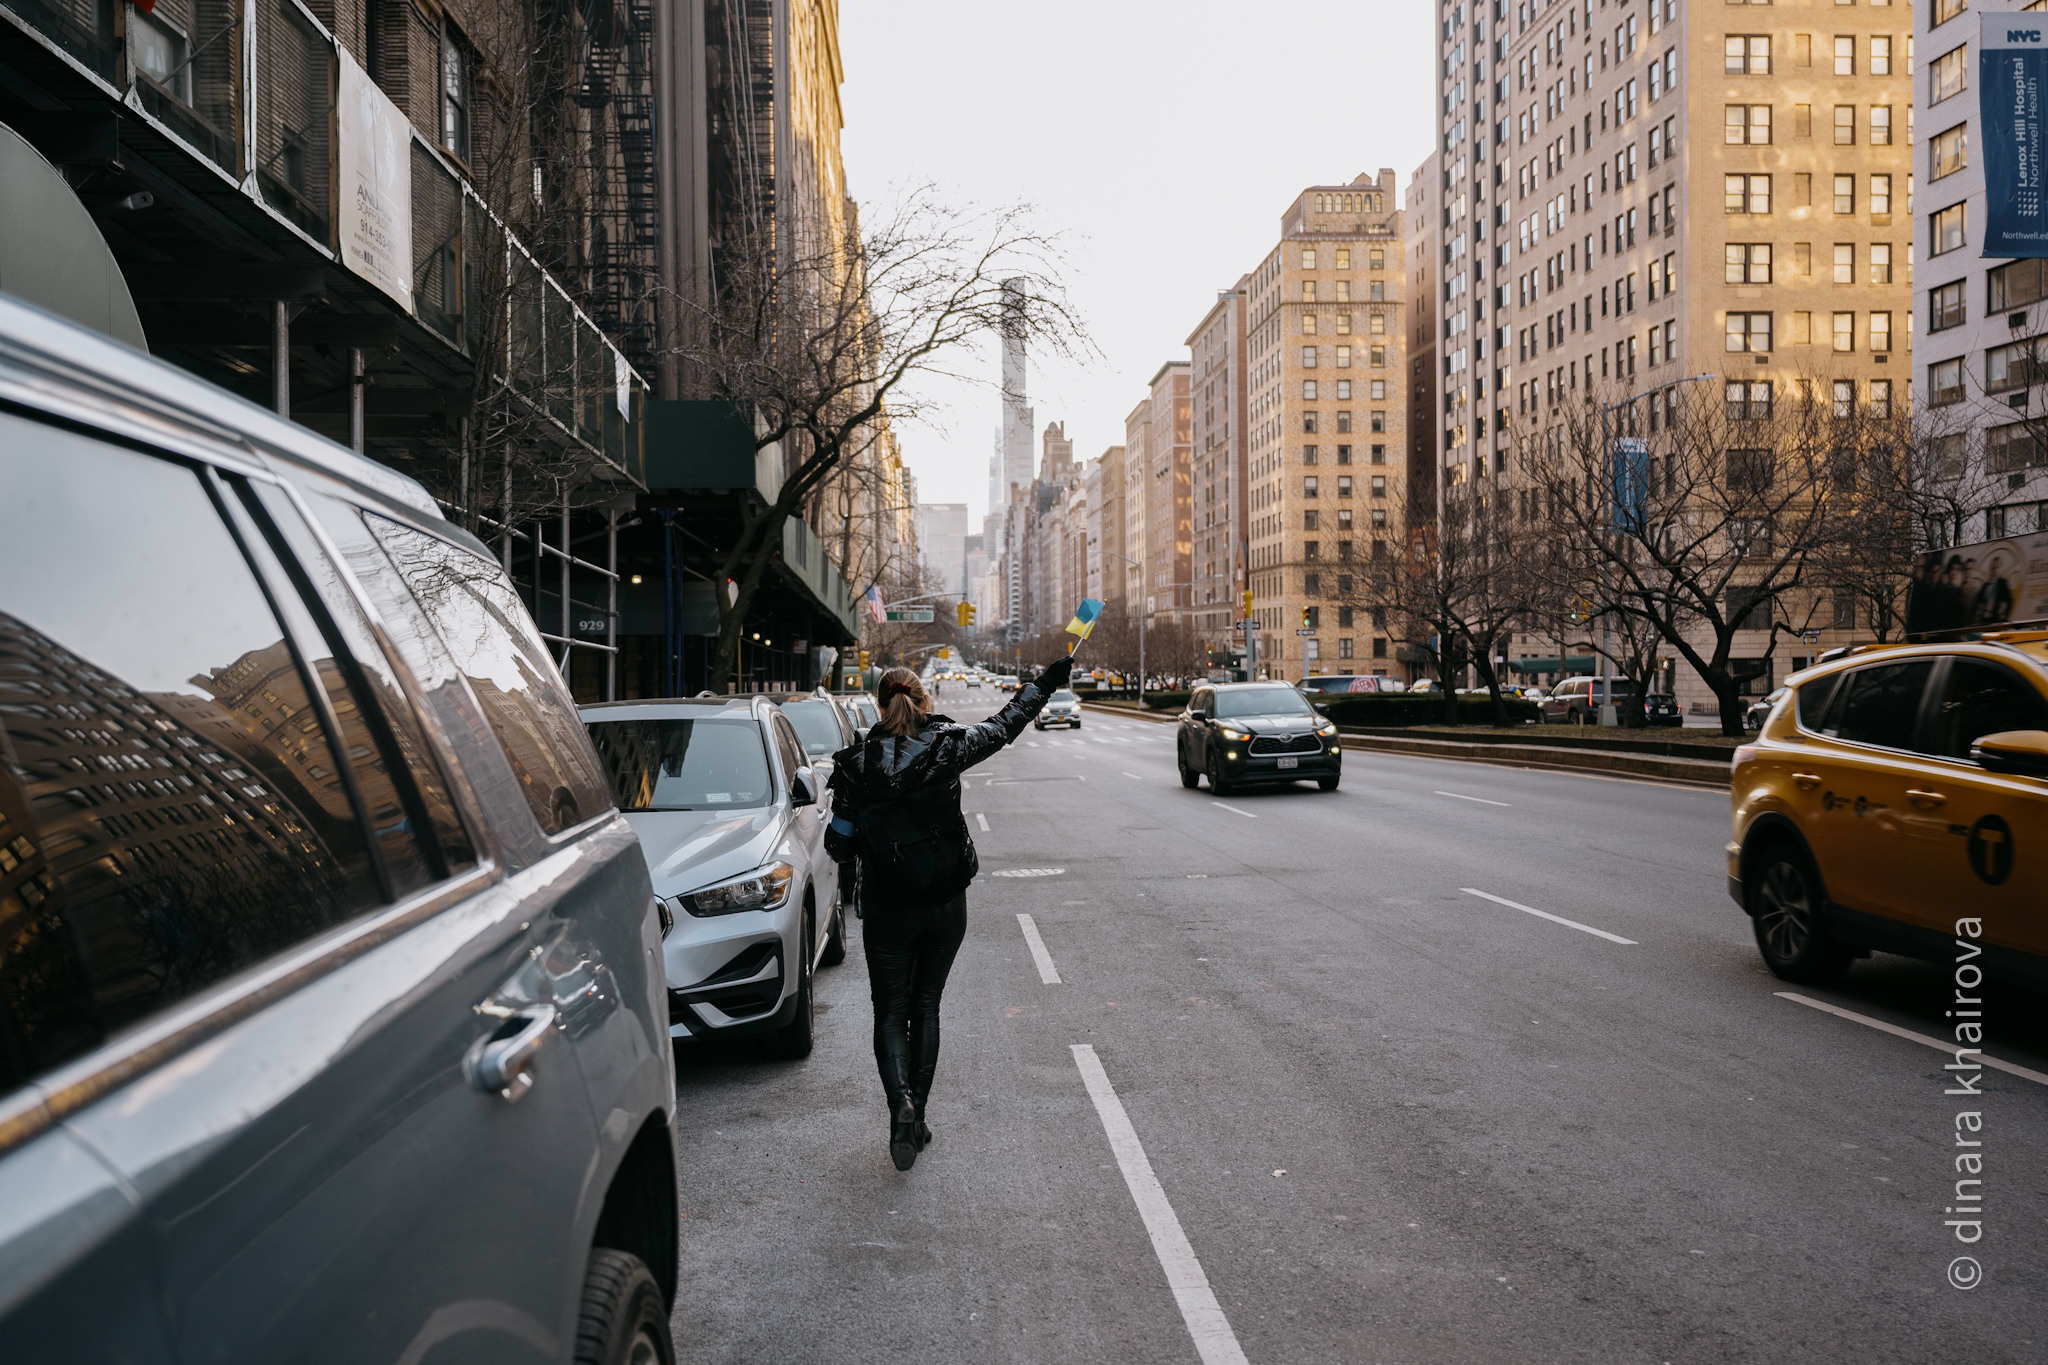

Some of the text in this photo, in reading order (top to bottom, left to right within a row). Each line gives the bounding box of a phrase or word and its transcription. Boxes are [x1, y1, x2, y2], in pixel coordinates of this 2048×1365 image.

[2007, 30, 2041, 43] NYC
[2013, 57, 2028, 187] Lenox Hill Hospital
[2027, 77, 2039, 187] Northwell Health
[579, 620, 605, 631] 929
